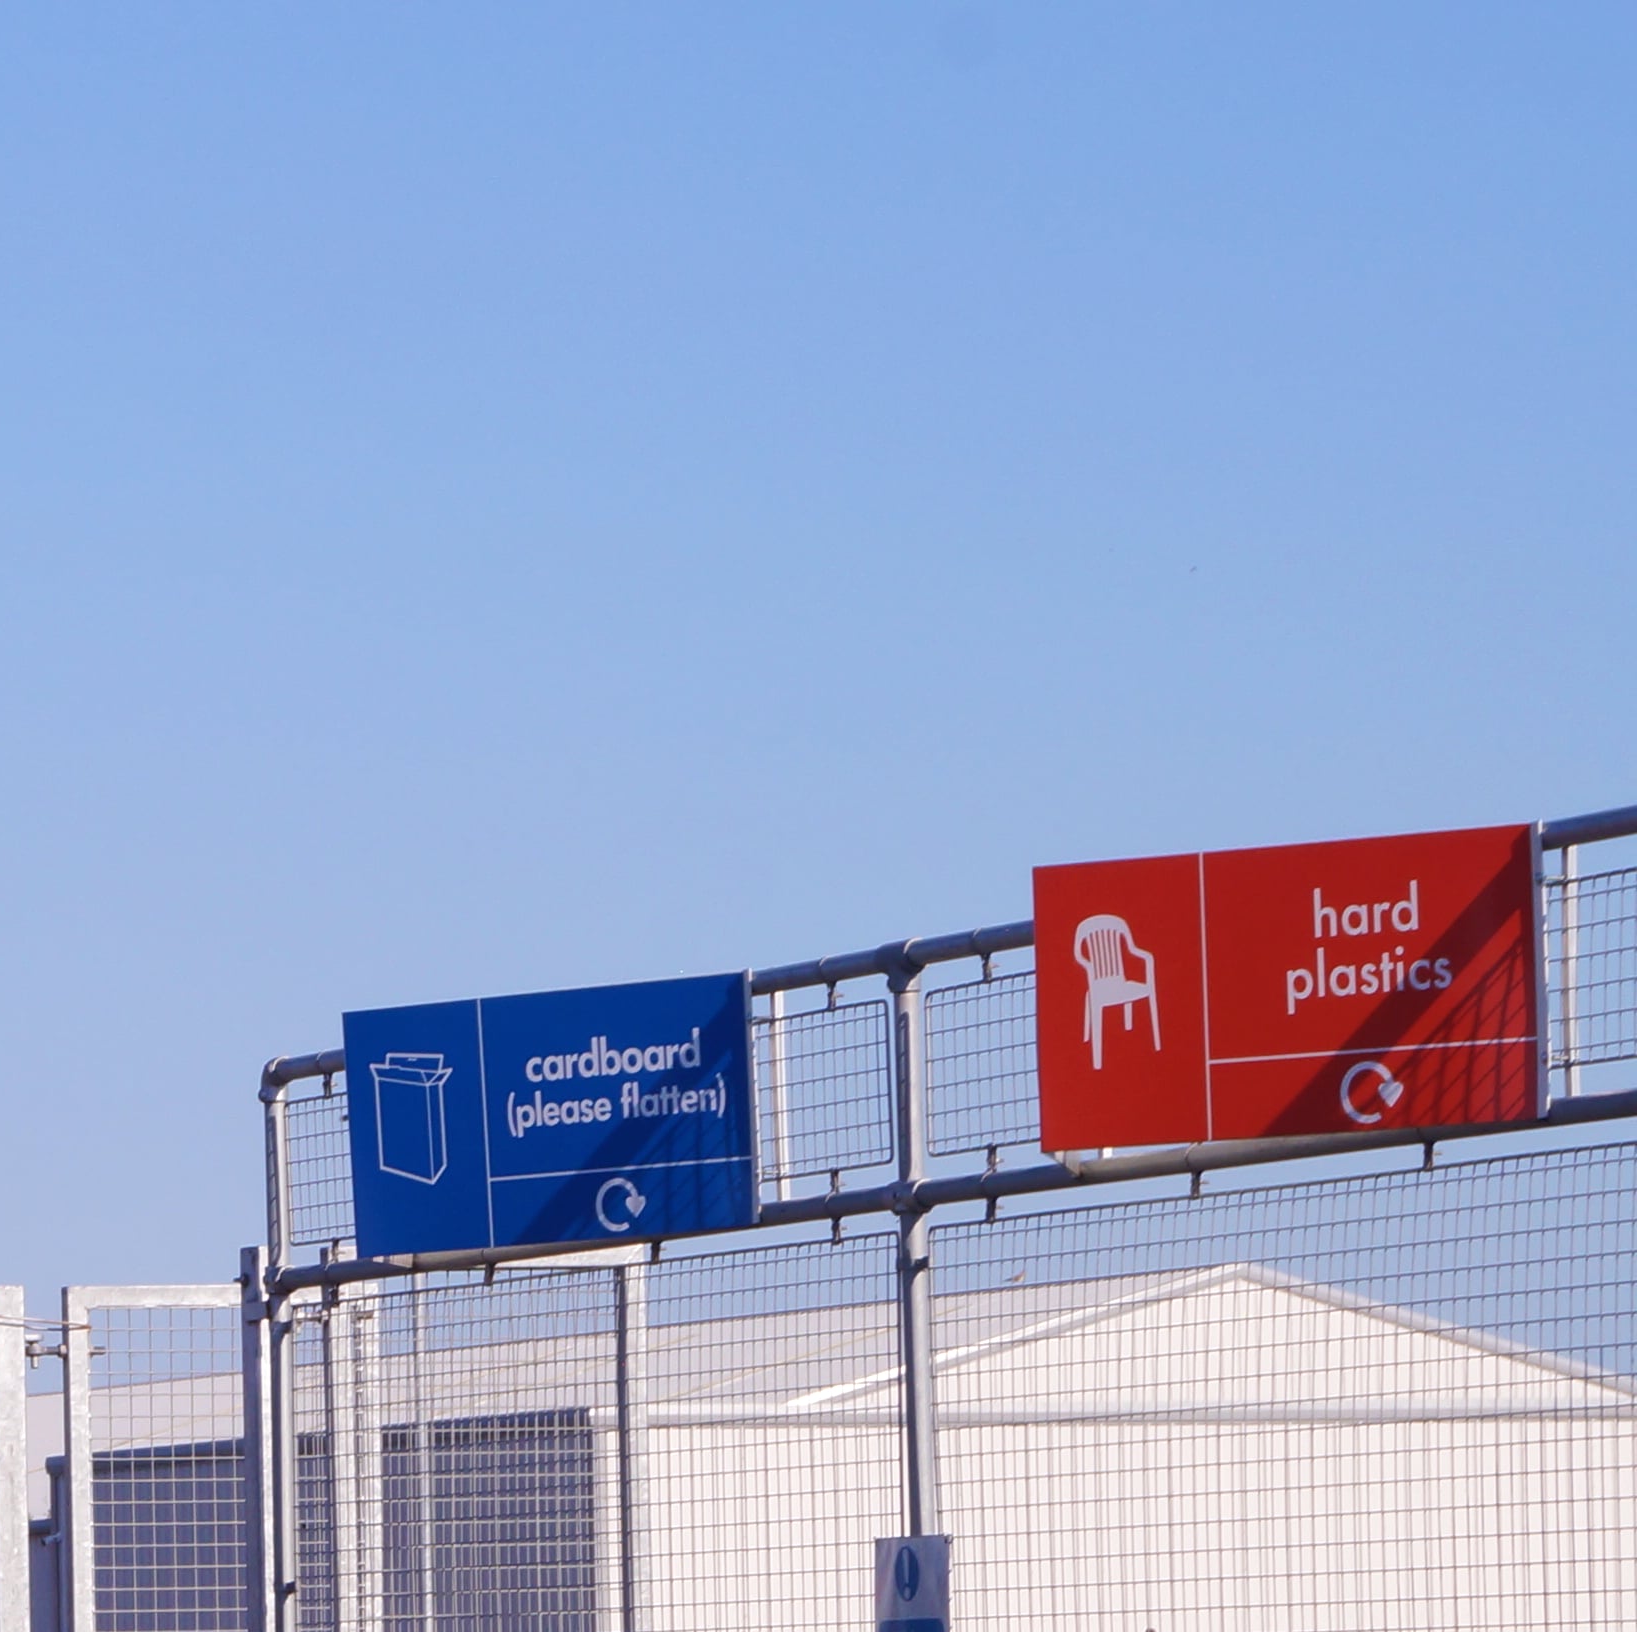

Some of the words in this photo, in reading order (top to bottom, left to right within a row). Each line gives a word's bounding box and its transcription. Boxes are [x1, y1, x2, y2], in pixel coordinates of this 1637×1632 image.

[1313, 879, 1419, 938] hard
[1286, 946, 1453, 1015] plastics
[525, 1027, 701, 1082] cardboard
[507, 1091, 612, 1138] (please
[621, 1072, 726, 1119] flatten)
